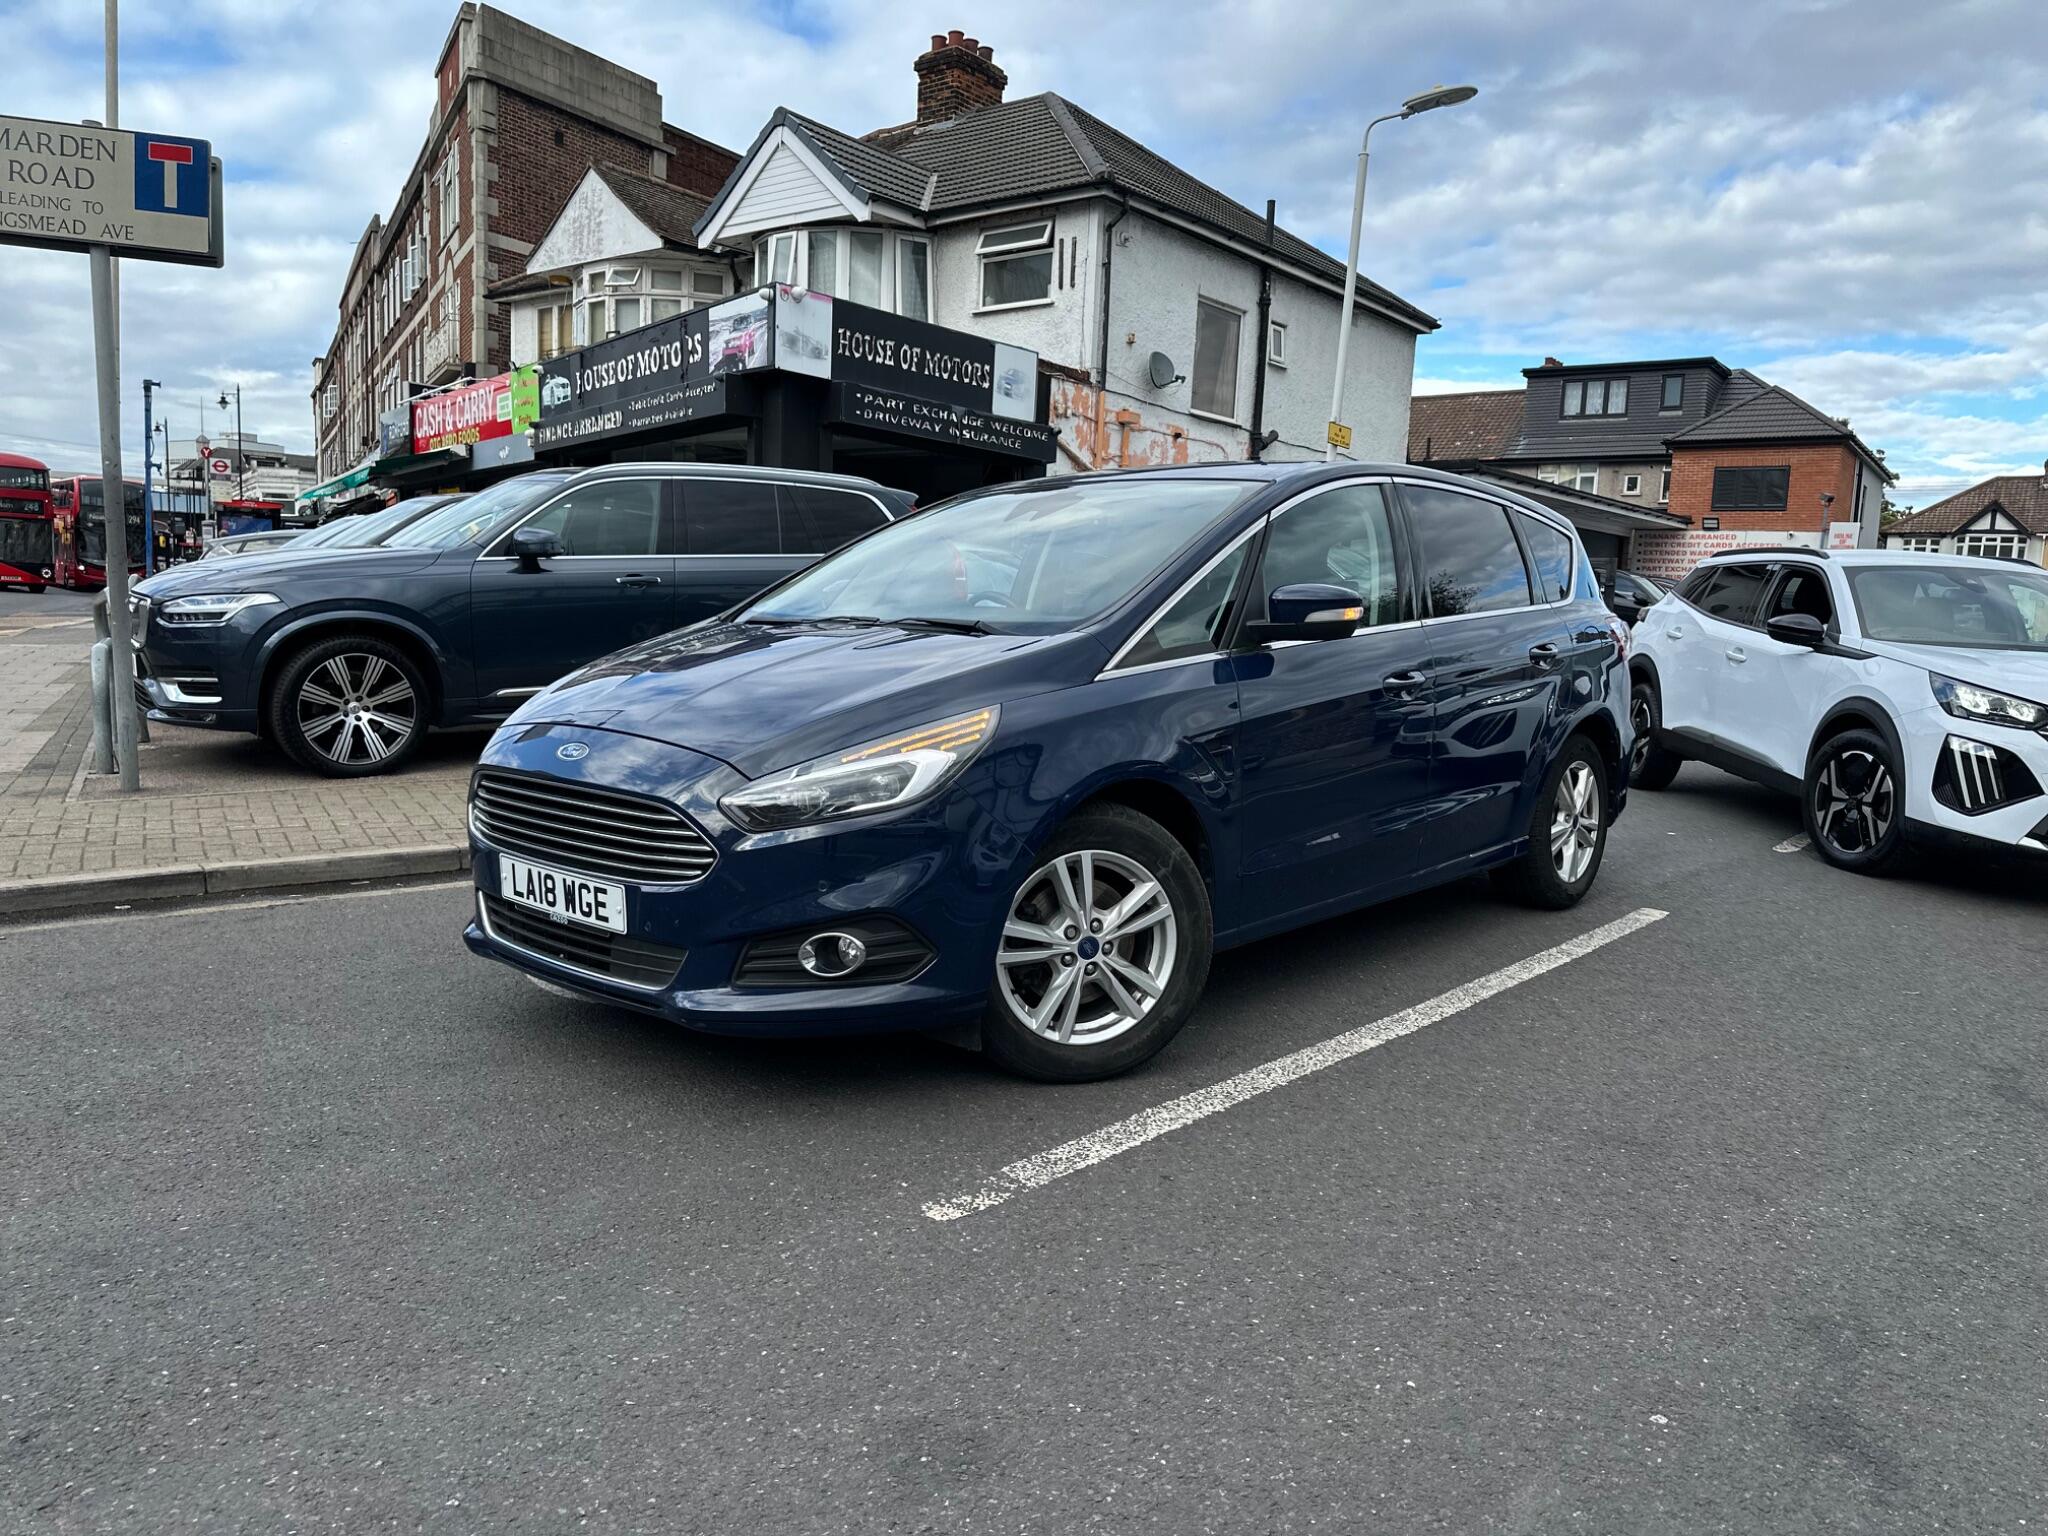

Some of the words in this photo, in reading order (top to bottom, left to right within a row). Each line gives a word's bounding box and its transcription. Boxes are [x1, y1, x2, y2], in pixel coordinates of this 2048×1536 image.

[8, 159, 95, 190] ROAD
[0, 191, 71, 212] LEADING
[83, 201, 104, 215] TO
[0, 211, 86, 235] GSMEAD
[100, 224, 135, 241] AVE
[575, 361, 616, 394] HOUSE
[617, 353, 635, 382] OF
[837, 328, 896, 366] HOUSE
[900, 344, 921, 372] OF
[924, 350, 991, 389] MOTORS
[416, 401, 443, 438] CASH
[445, 399, 454, 432] &
[456, 385, 495, 428] CARRY
[539, 421, 572, 444] FINANCE
[574, 411, 623, 437] ARRANGED
[864, 394, 905, 411] PART
[913, 404, 985, 429] EXCHANGE
[990, 421, 1049, 442] WELCOME
[458, 427, 480, 445] FOODS
[864, 409, 943, 433] DRIVEWAY
[949, 426, 1022, 449] INSURANCE
[128, 515, 140, 524] 294
[1642, 549, 1687, 557] EXTENDED
[511, 863, 557, 909] LA18
[563, 877, 610, 924] WGE
